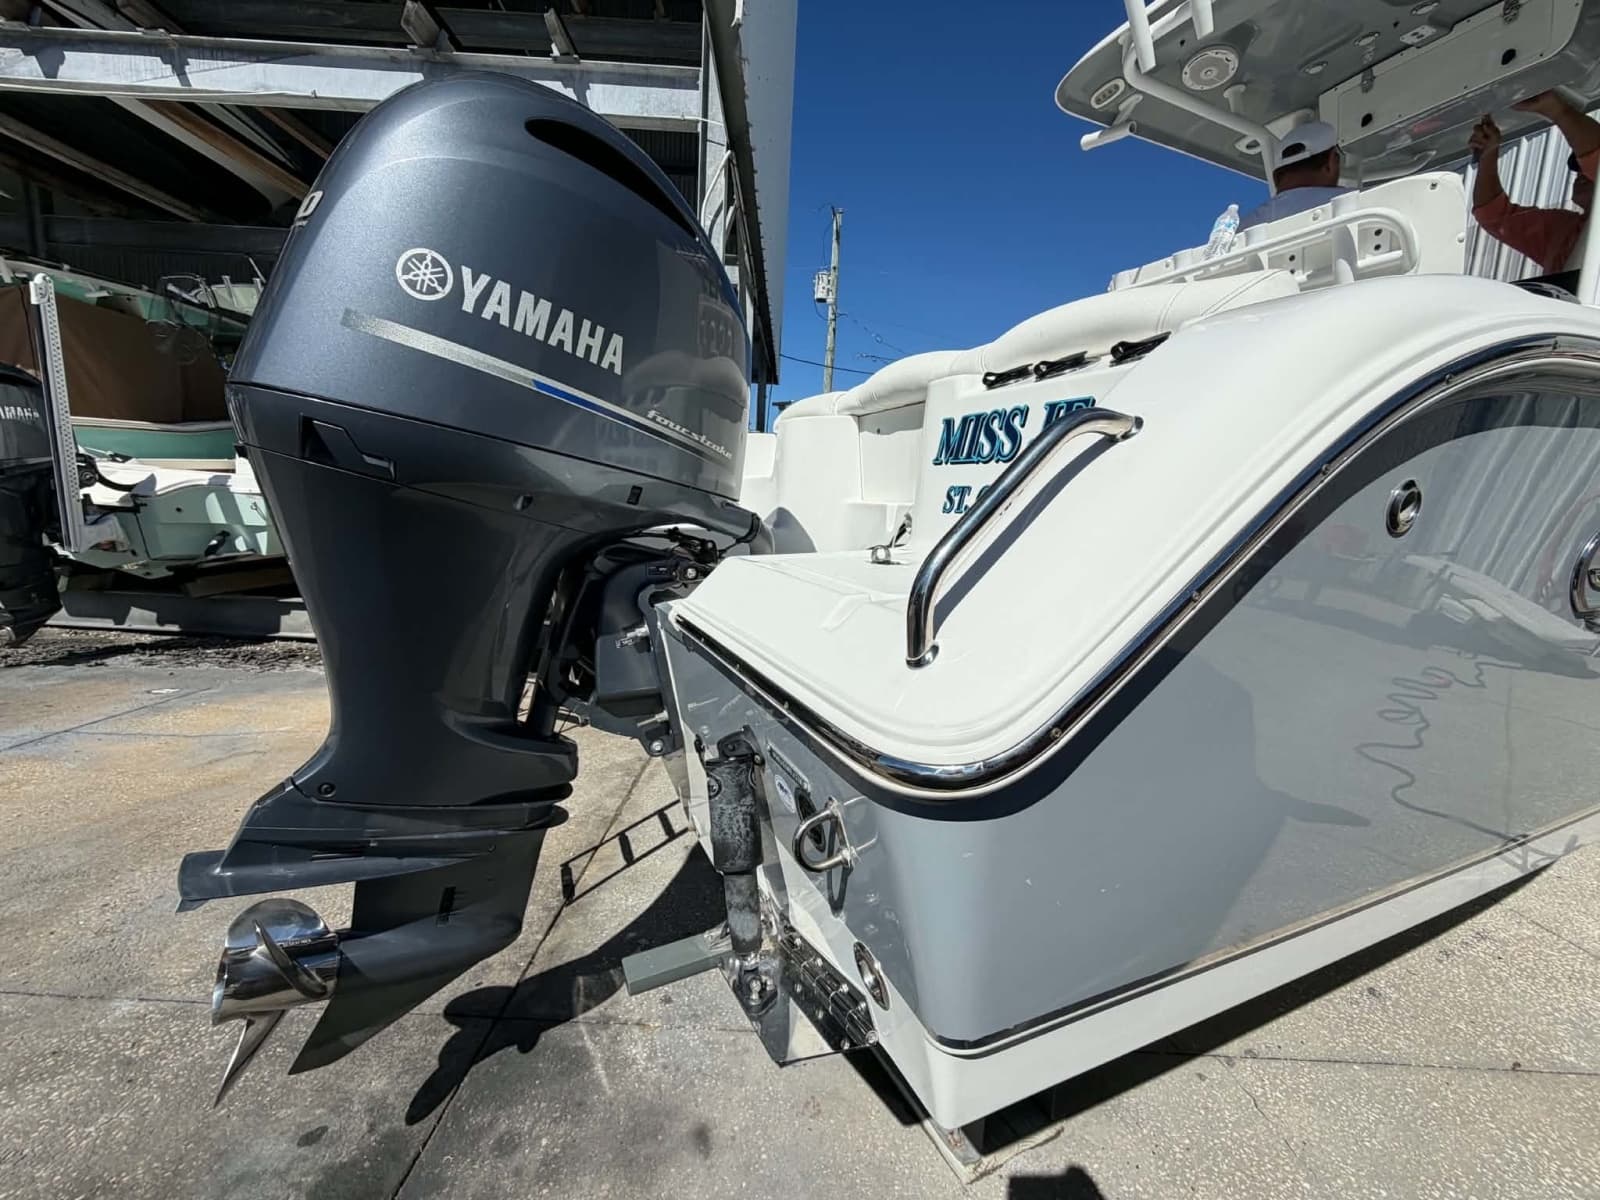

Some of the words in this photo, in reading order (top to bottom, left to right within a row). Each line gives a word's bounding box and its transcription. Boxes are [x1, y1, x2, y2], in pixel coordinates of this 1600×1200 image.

[460, 265, 624, 376] YAMAHA
[646, 410, 733, 460] fourstroke
[932, 403, 1030, 466] MISS
